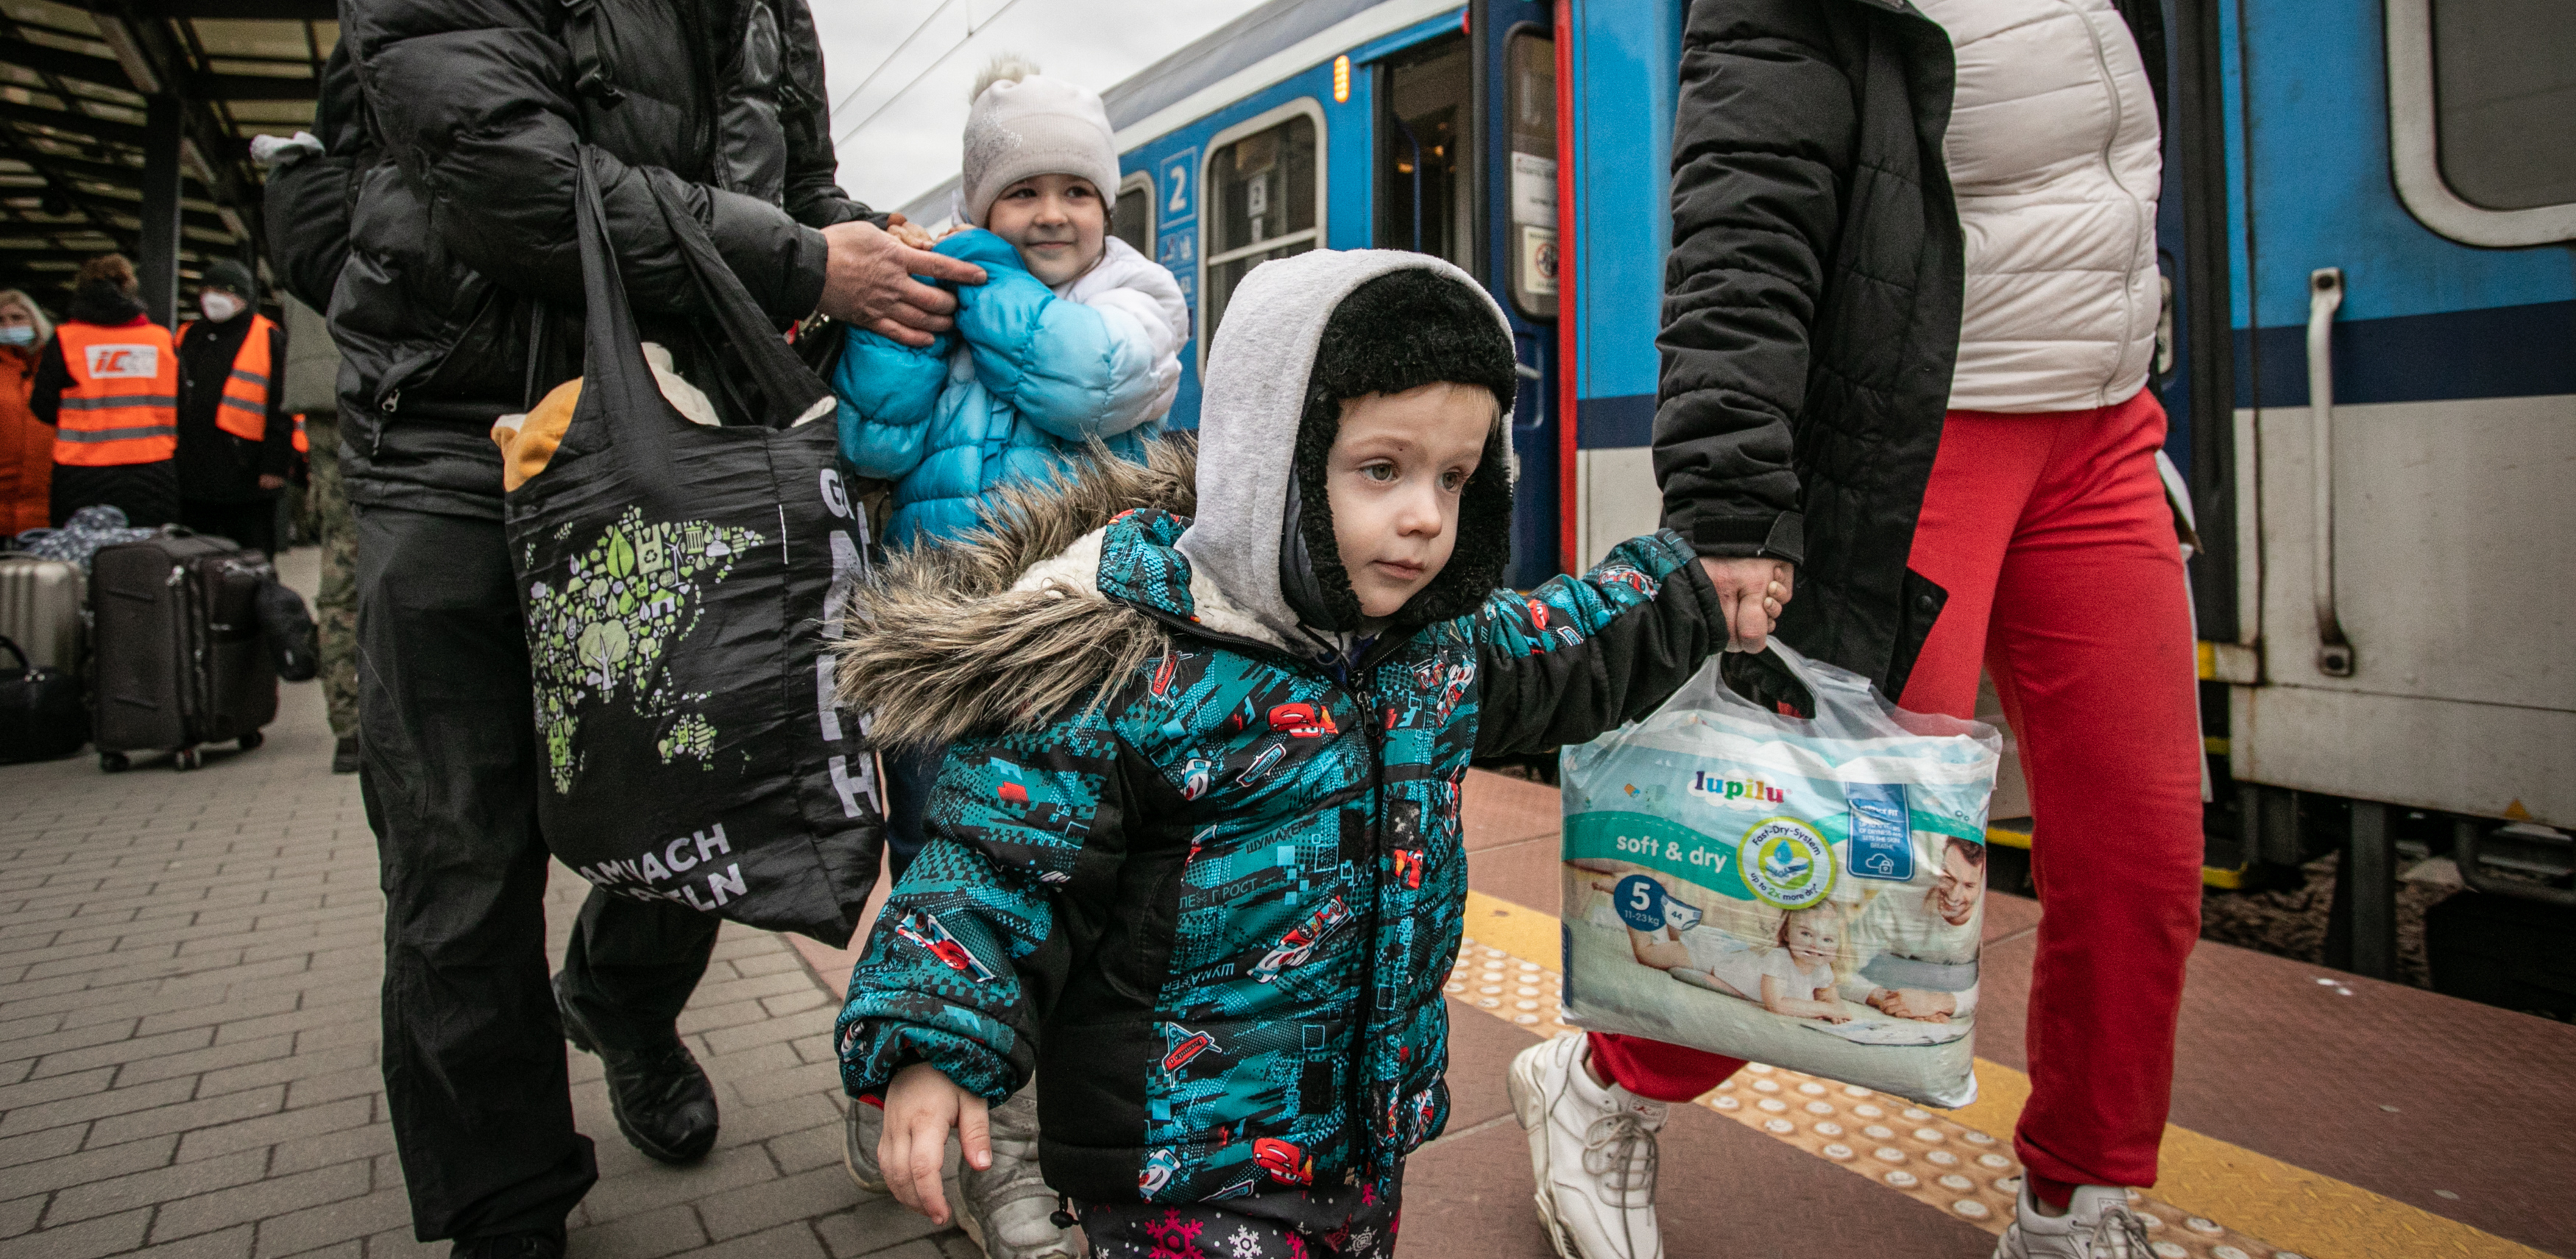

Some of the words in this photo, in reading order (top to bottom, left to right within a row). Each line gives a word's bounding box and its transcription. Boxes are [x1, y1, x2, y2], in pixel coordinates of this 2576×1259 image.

[1168, 164, 1187, 213] 2
[1694, 771, 1784, 803] lupilu
[1616, 835, 1659, 857] soft
[1665, 842, 1682, 862] &
[1689, 845, 1727, 873] dry
[1752, 826, 1821, 856] Fast-Dry-System
[1630, 882, 1650, 910] 5
[1751, 873, 1760, 883] up
[1767, 887, 1780, 899] 2x
[1624, 910, 1647, 922] 11-23
[1649, 915, 1660, 926] kg
[1671, 911, 1682, 920] 44
